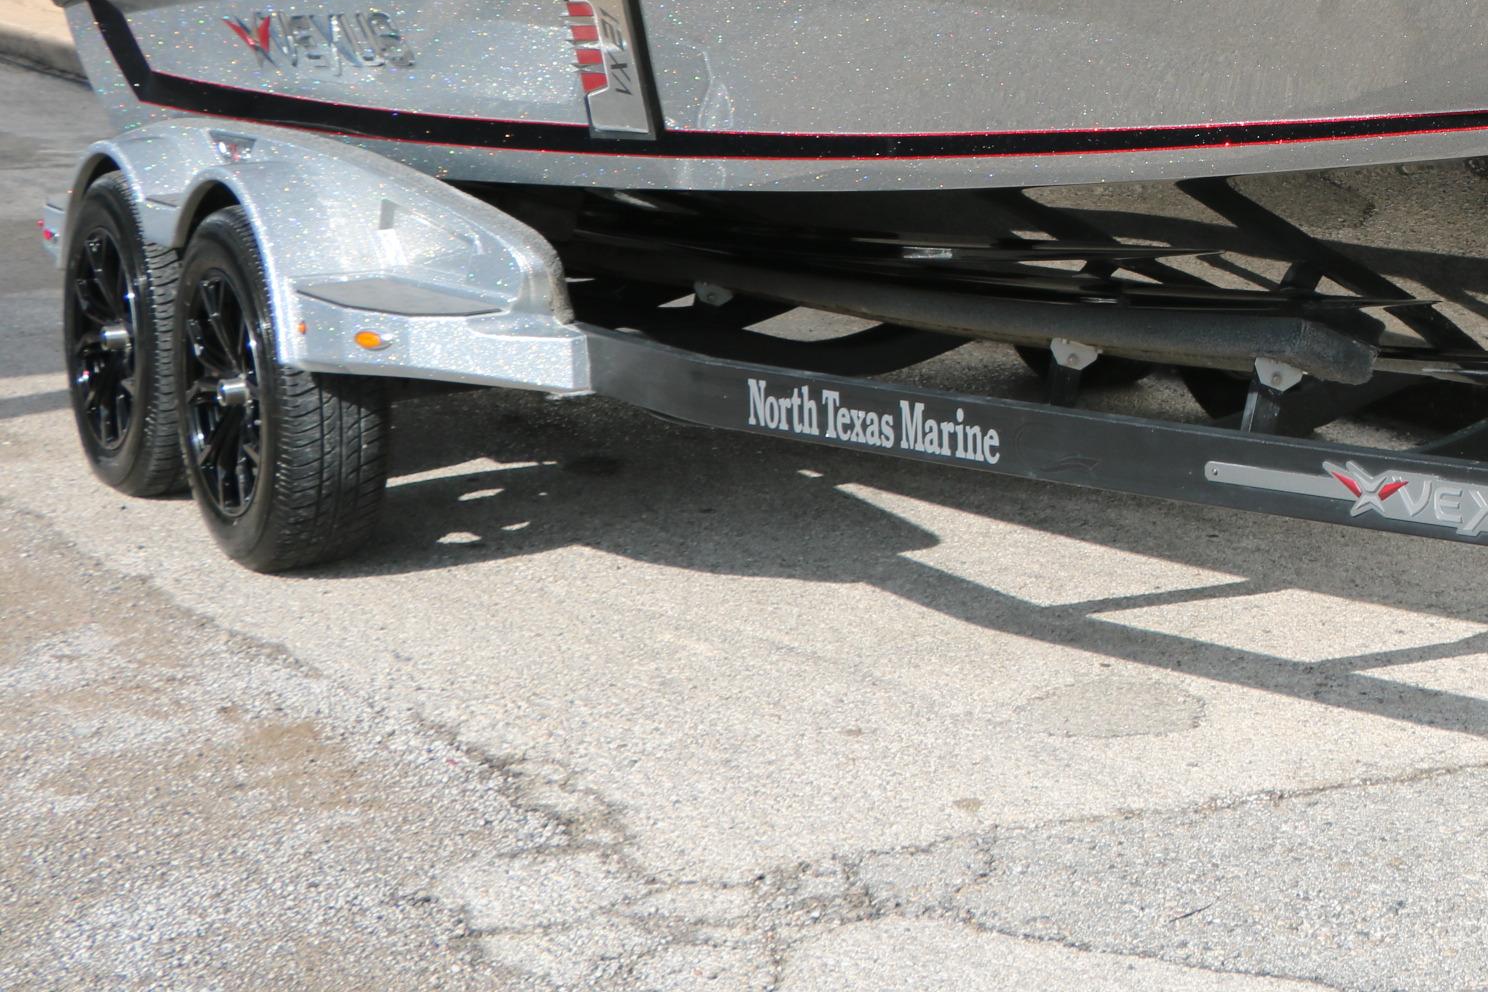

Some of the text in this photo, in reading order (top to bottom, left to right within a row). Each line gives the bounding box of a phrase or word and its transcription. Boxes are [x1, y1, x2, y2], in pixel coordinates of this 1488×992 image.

[748, 379, 1000, 464] North Texas Marine
